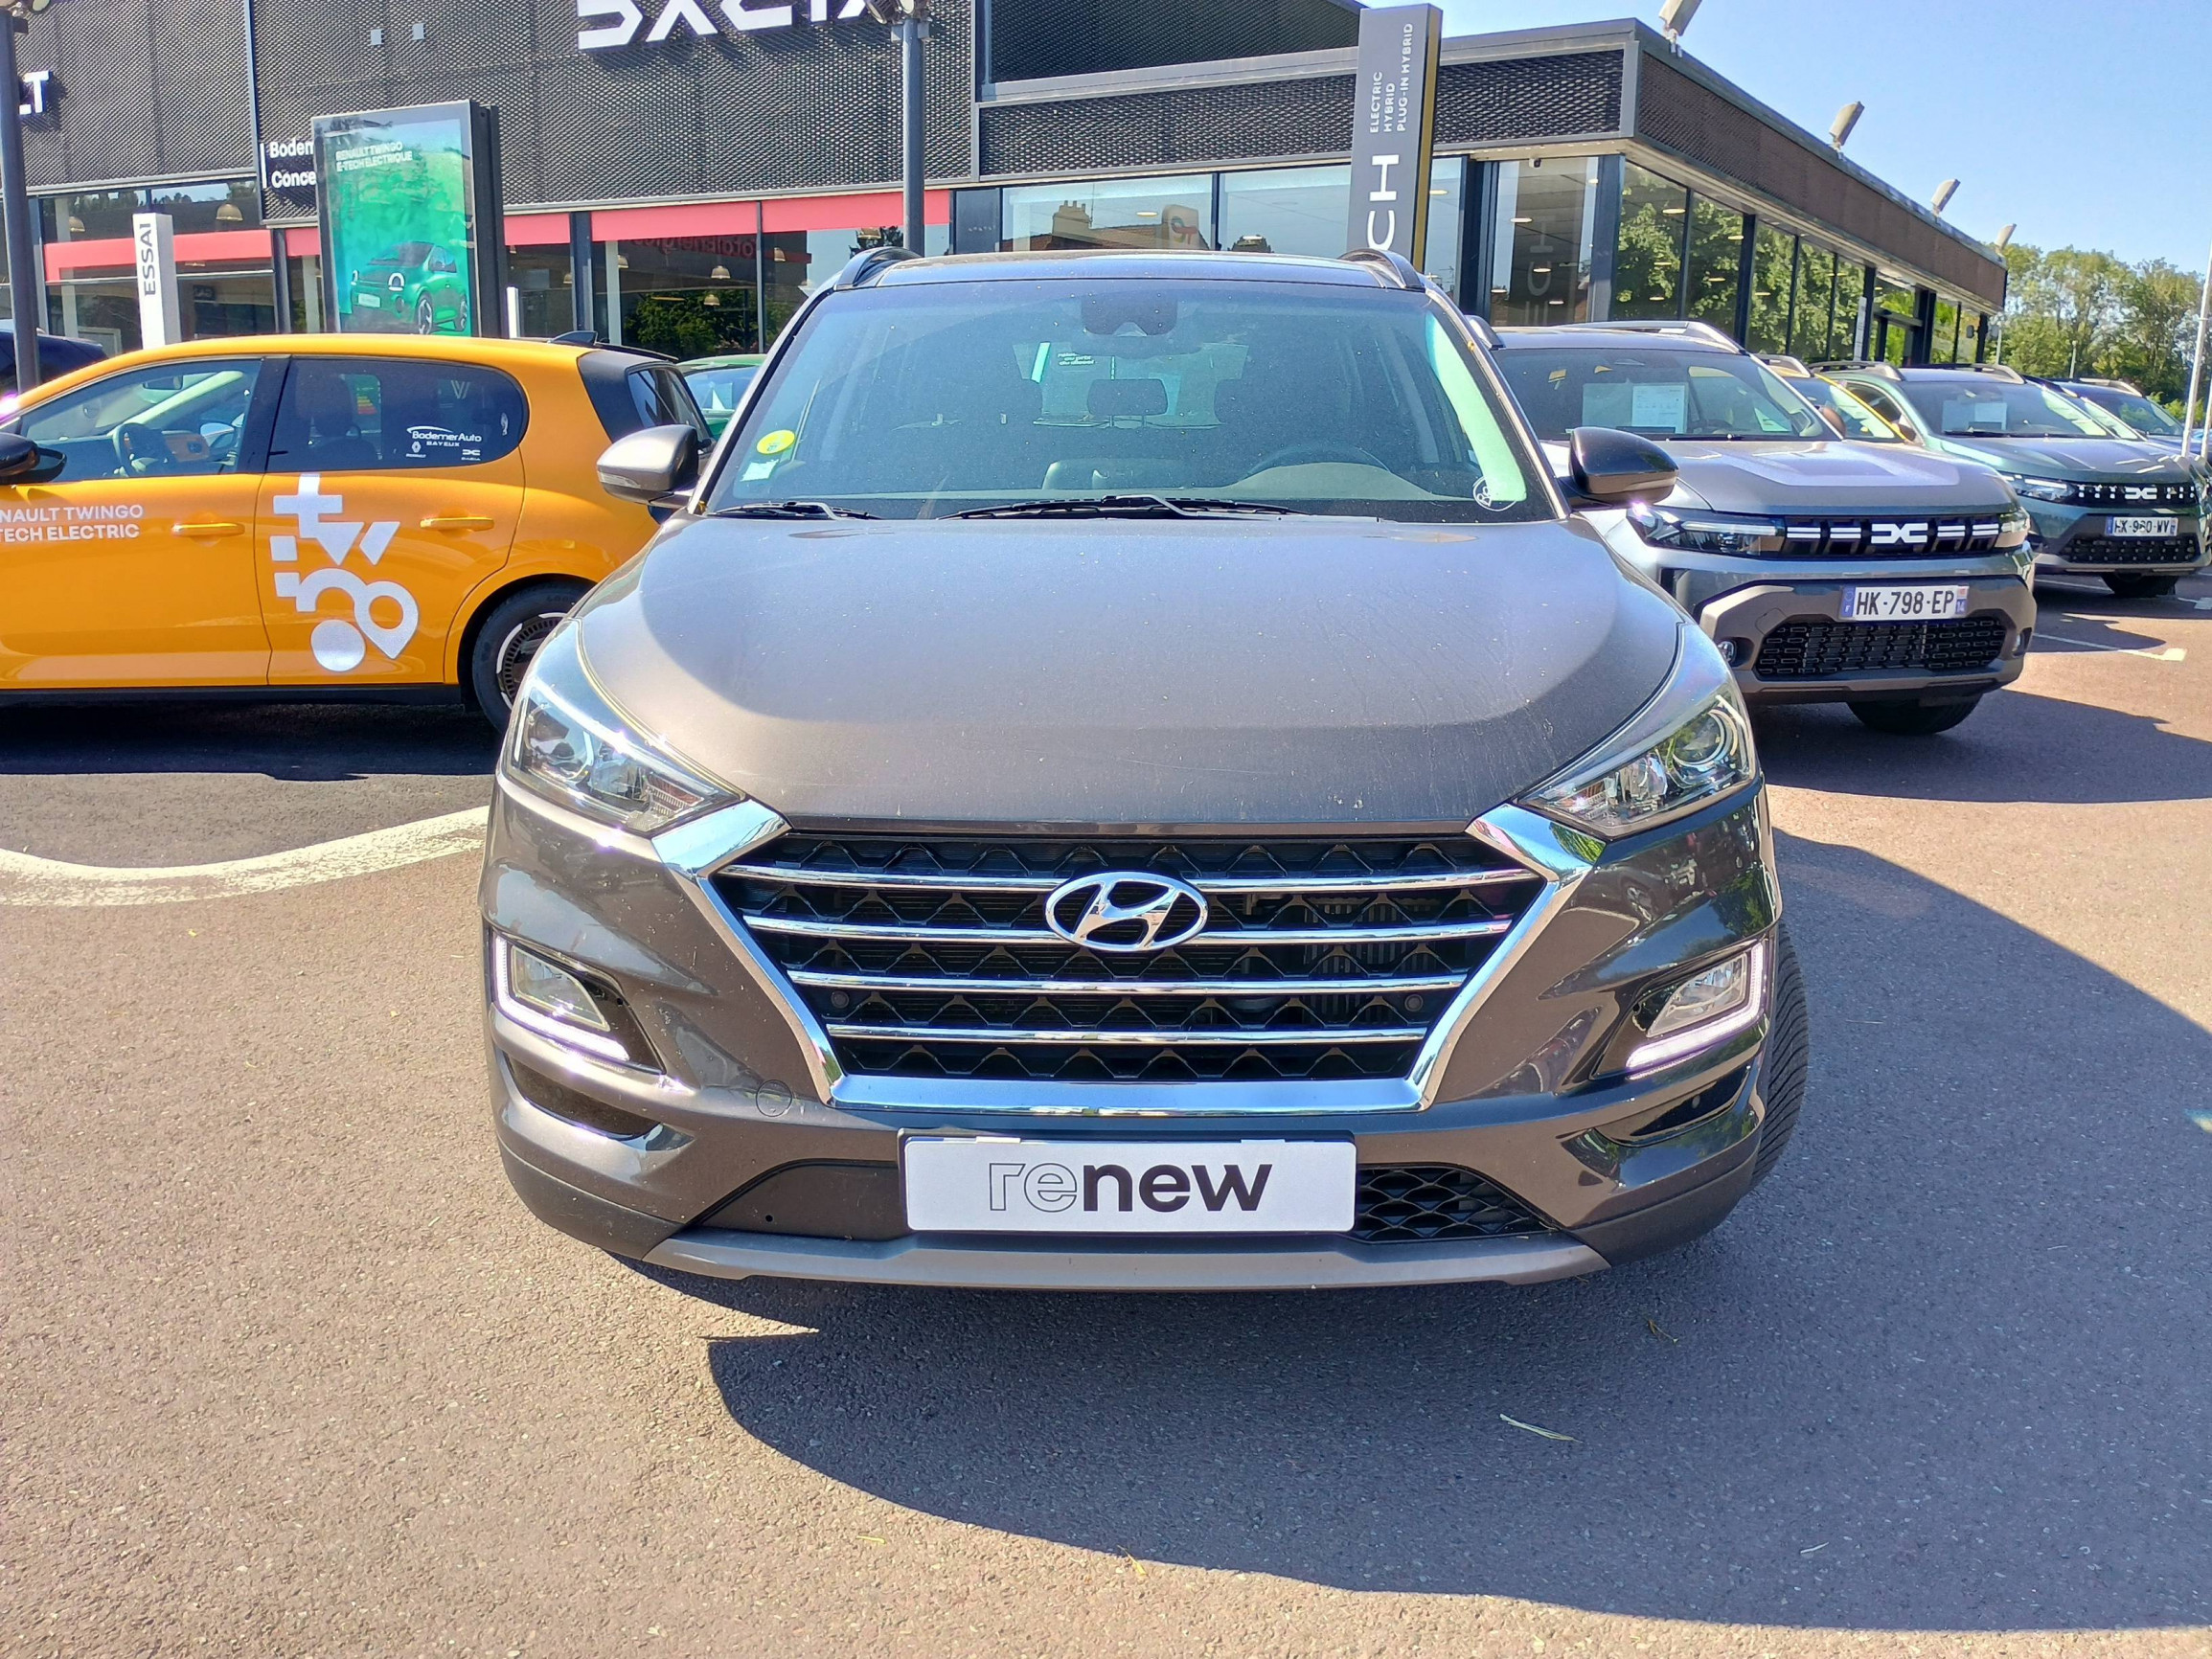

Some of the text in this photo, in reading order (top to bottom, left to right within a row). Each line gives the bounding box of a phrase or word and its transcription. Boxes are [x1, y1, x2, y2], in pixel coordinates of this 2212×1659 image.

[1370, 71, 1382, 133] ELECTRIC
[1397, 23, 1413, 132] PLUG-IN HYBRID
[1383, 82, 1396, 132] HYBRID
[139, 223, 156, 296] ESSAI
[48, 523, 140, 541] ELECTRIC
[63, 504, 144, 520] TWINGO
[1856, 590, 1955, 616] HK-798-EP
[989, 1162, 1273, 1214] renew
